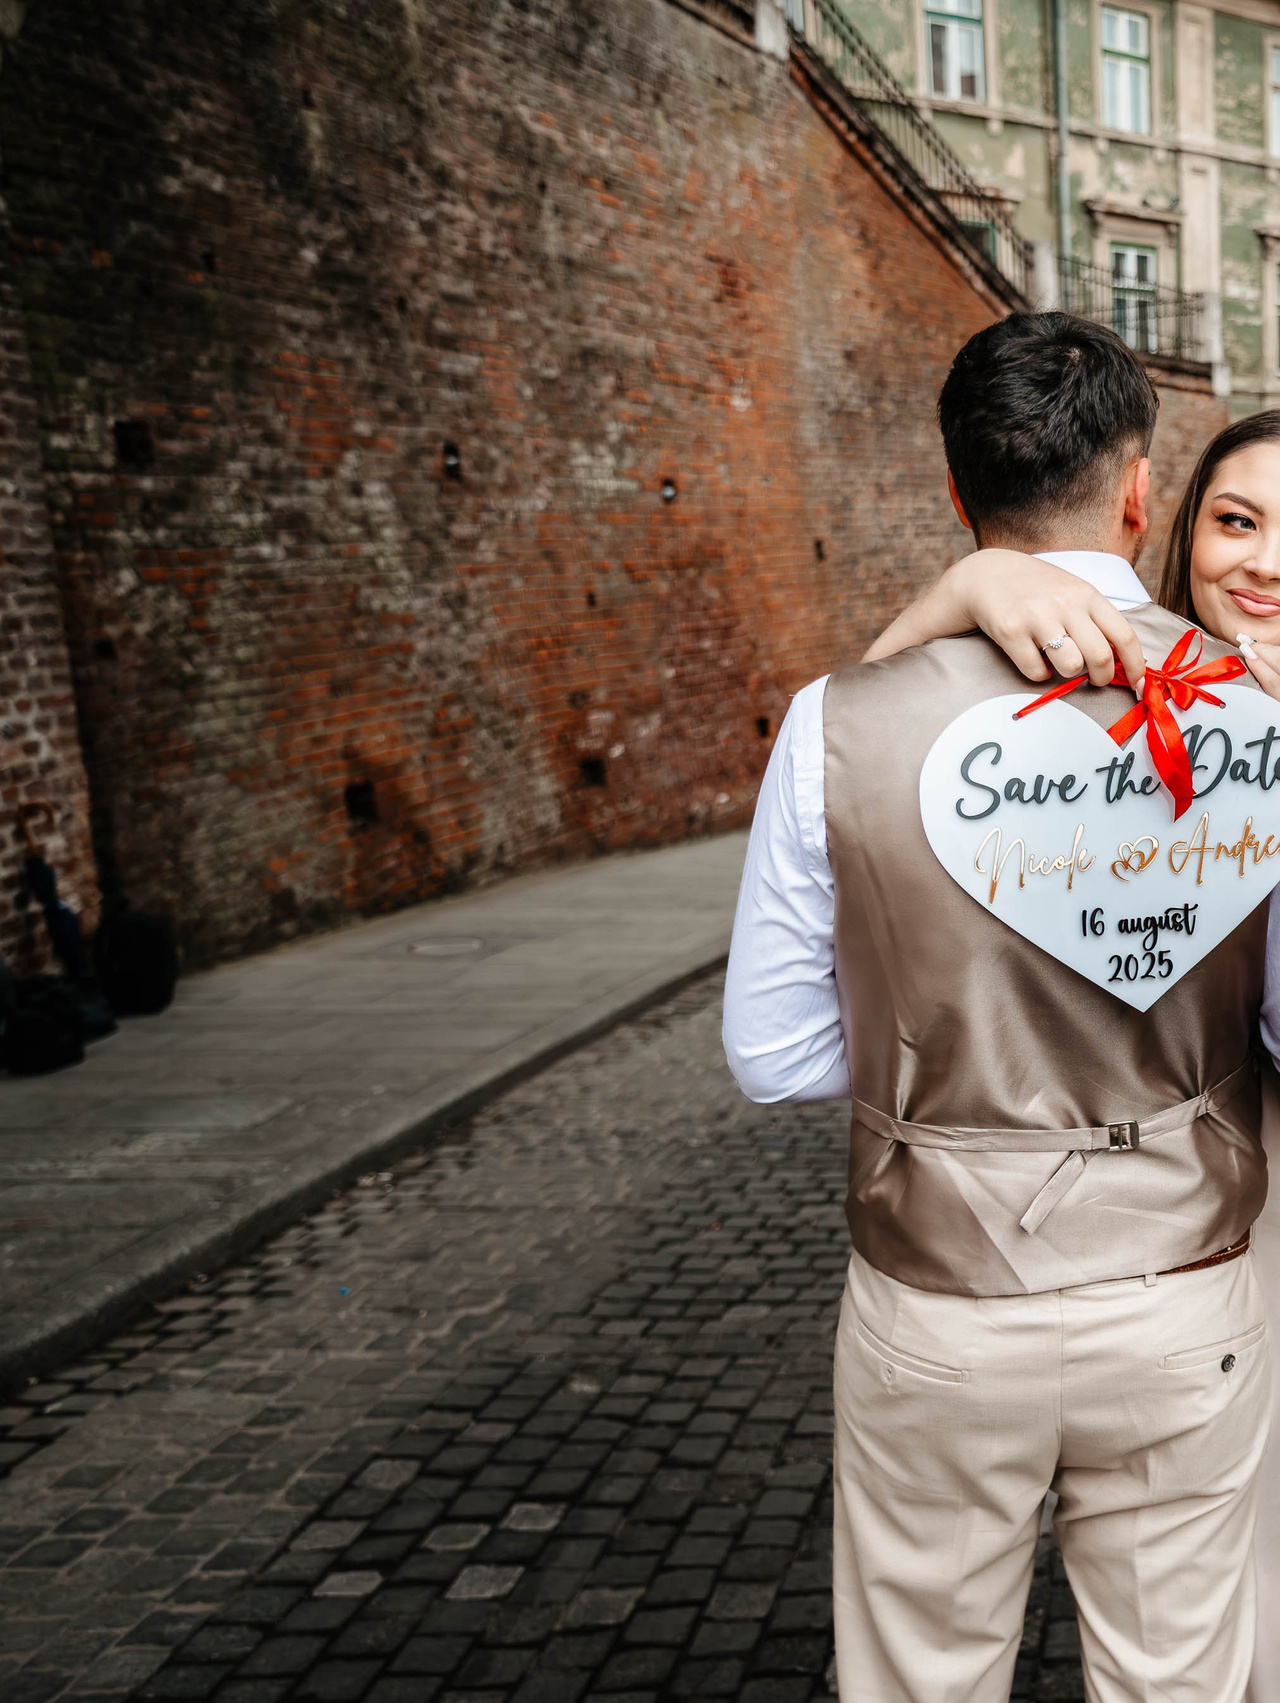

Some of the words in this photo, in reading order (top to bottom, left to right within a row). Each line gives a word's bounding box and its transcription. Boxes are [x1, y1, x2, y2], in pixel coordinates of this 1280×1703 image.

[956, 741, 1088, 820] Save
[1095, 751, 1162, 804] the
[974, 823, 1096, 905] Nicole
[1081, 907, 1105, 937] 16
[1117, 903, 1199, 950] august
[1107, 950, 1174, 982] 2025
